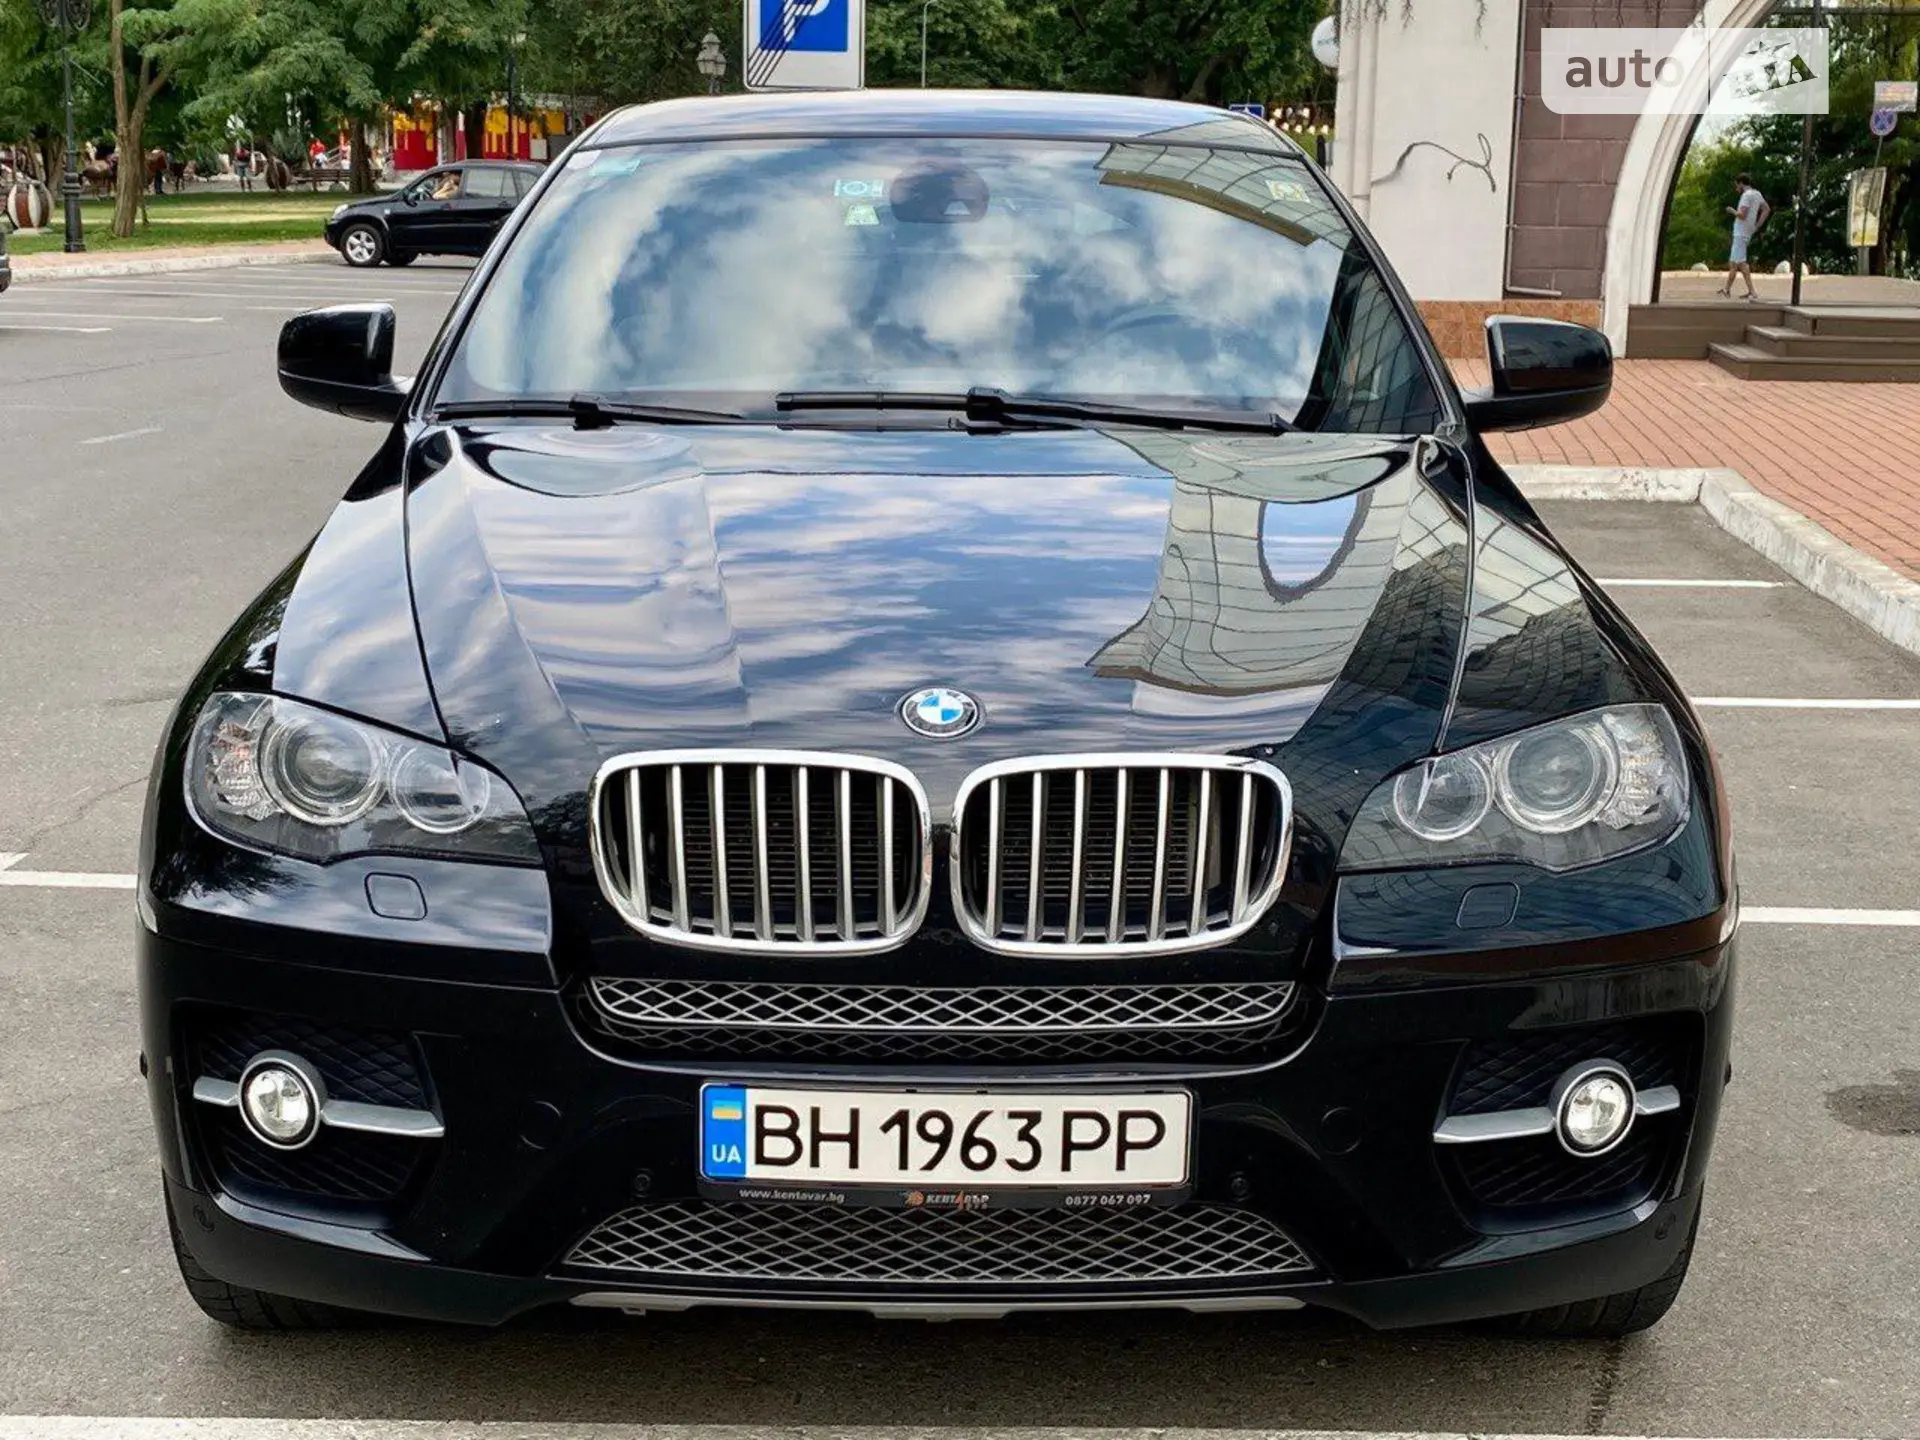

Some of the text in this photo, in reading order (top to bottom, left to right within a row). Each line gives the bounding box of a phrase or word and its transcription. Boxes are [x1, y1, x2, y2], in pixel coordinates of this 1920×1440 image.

[755, 1105, 1166, 1171] BH 1963 PP
[712, 1144, 741, 1163] UA
[739, 1189, 844, 1204] www.kentavar.bg
[1065, 1193, 1151, 1206] 0877 067 097
